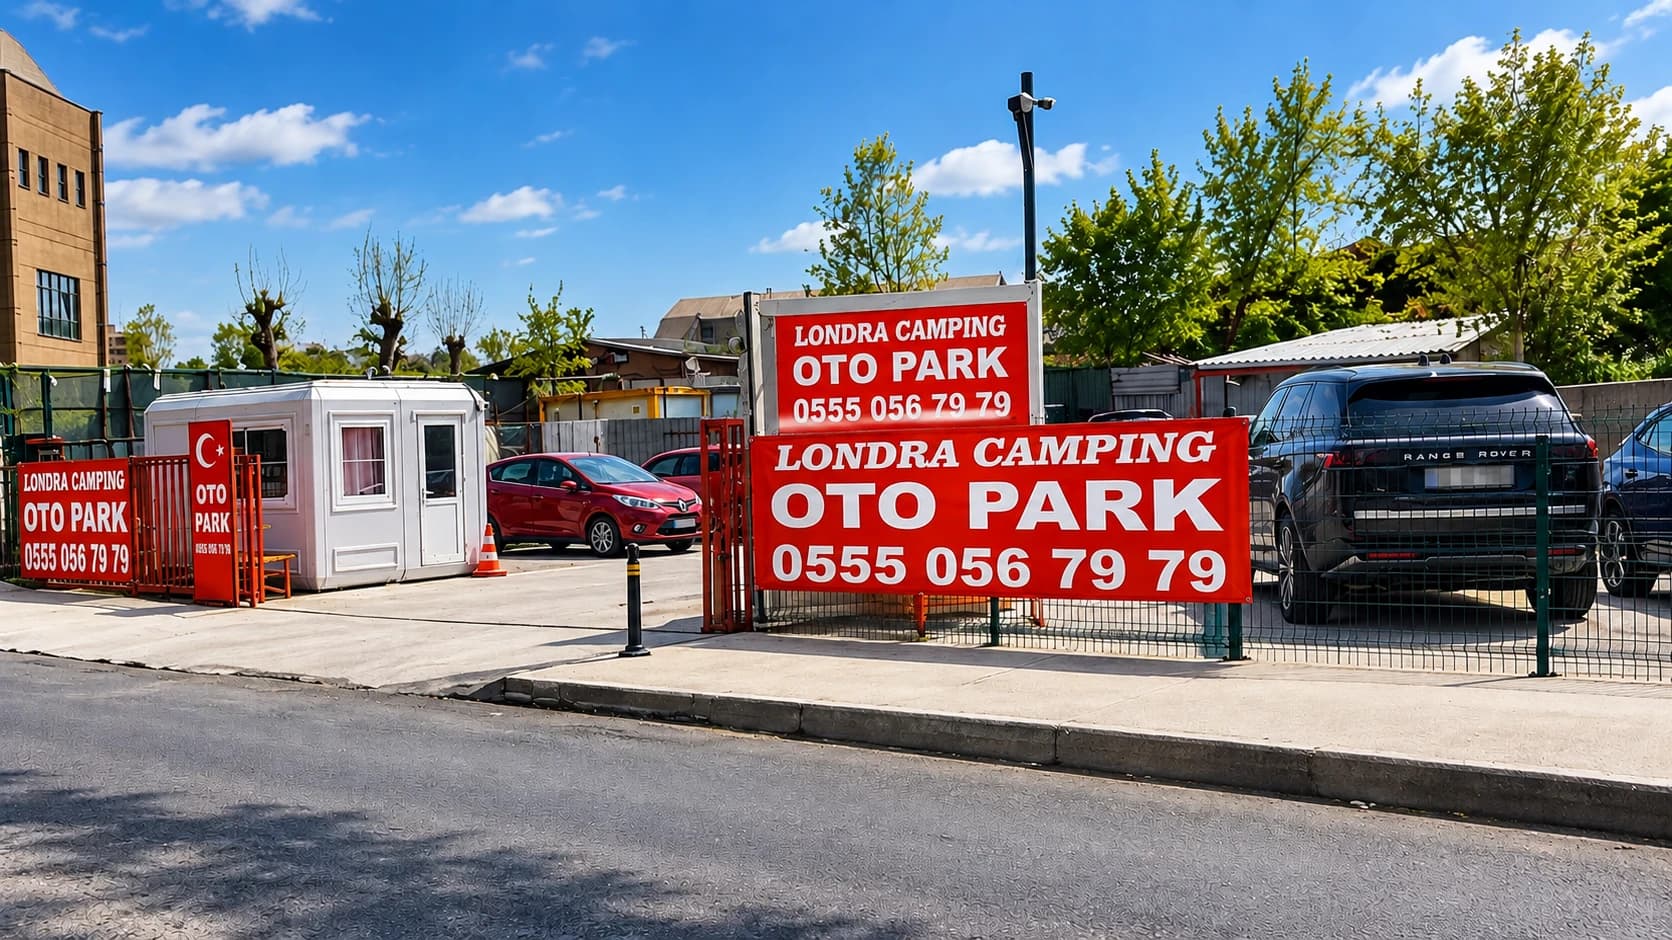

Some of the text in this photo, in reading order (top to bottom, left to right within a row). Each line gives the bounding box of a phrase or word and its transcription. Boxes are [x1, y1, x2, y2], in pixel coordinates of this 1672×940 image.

[794, 315, 1006, 346] LONDRA CAMPING
[793, 346, 1009, 386] OTO PARK
[794, 391, 1012, 424] 0555 056 79 79
[774, 431, 1217, 471] LONDRA CAMPING
[1404, 449, 1532, 461] RANGE ROVER
[24, 470, 125, 492] LONDRA CAMPING
[196, 484, 227, 505] OTO
[24, 501, 128, 532] OTO PARK
[771, 479, 1224, 531] OTO PARK
[195, 512, 230, 533] PARK
[25, 542, 129, 573] 0555 056 79 79
[772, 543, 1226, 592] 0555 056 79 79
